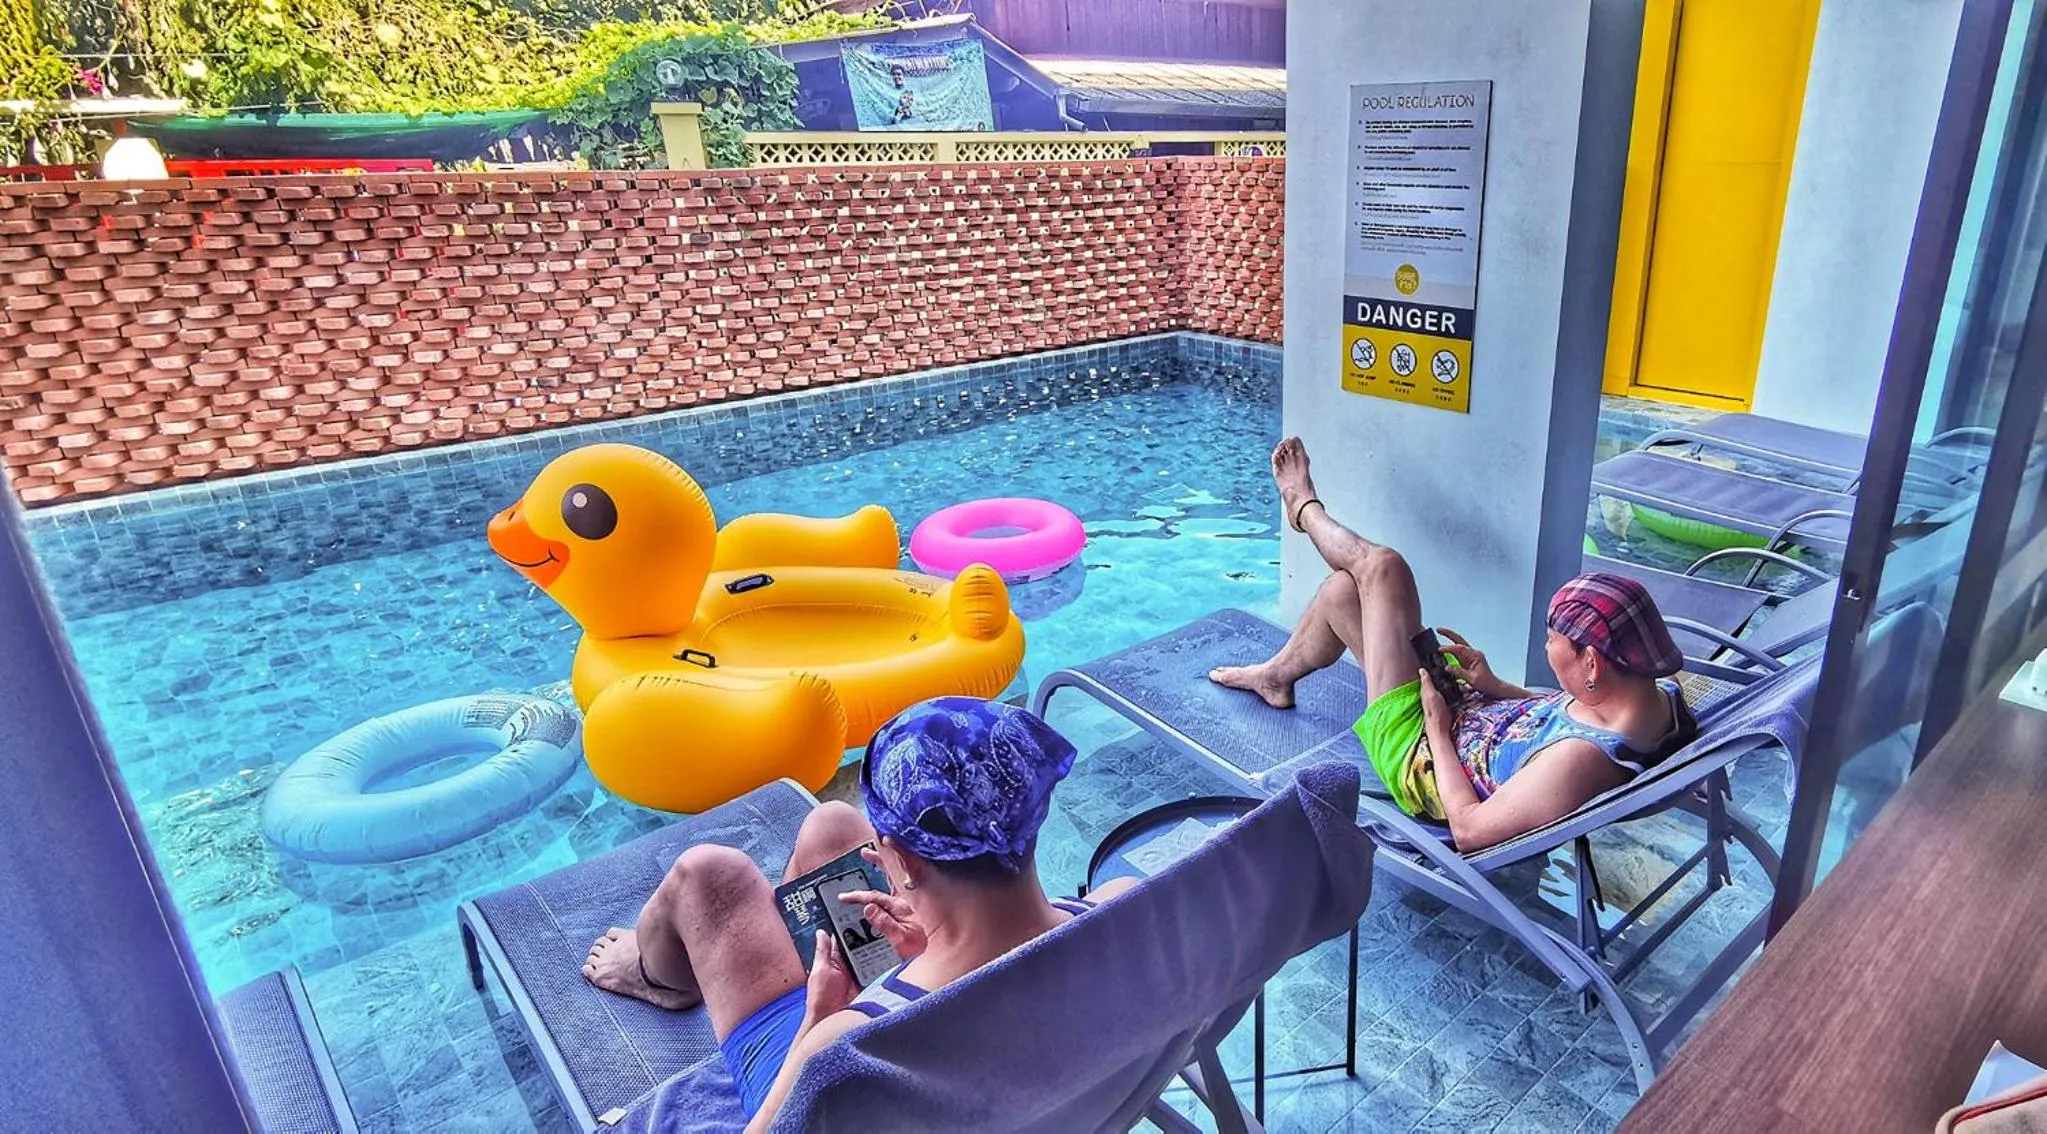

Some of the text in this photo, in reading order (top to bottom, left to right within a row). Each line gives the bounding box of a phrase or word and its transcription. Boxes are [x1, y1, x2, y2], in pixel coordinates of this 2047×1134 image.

[1363, 94, 1475, 110] POOL REGULATION
[1357, 302, 1456, 334] DANGER
